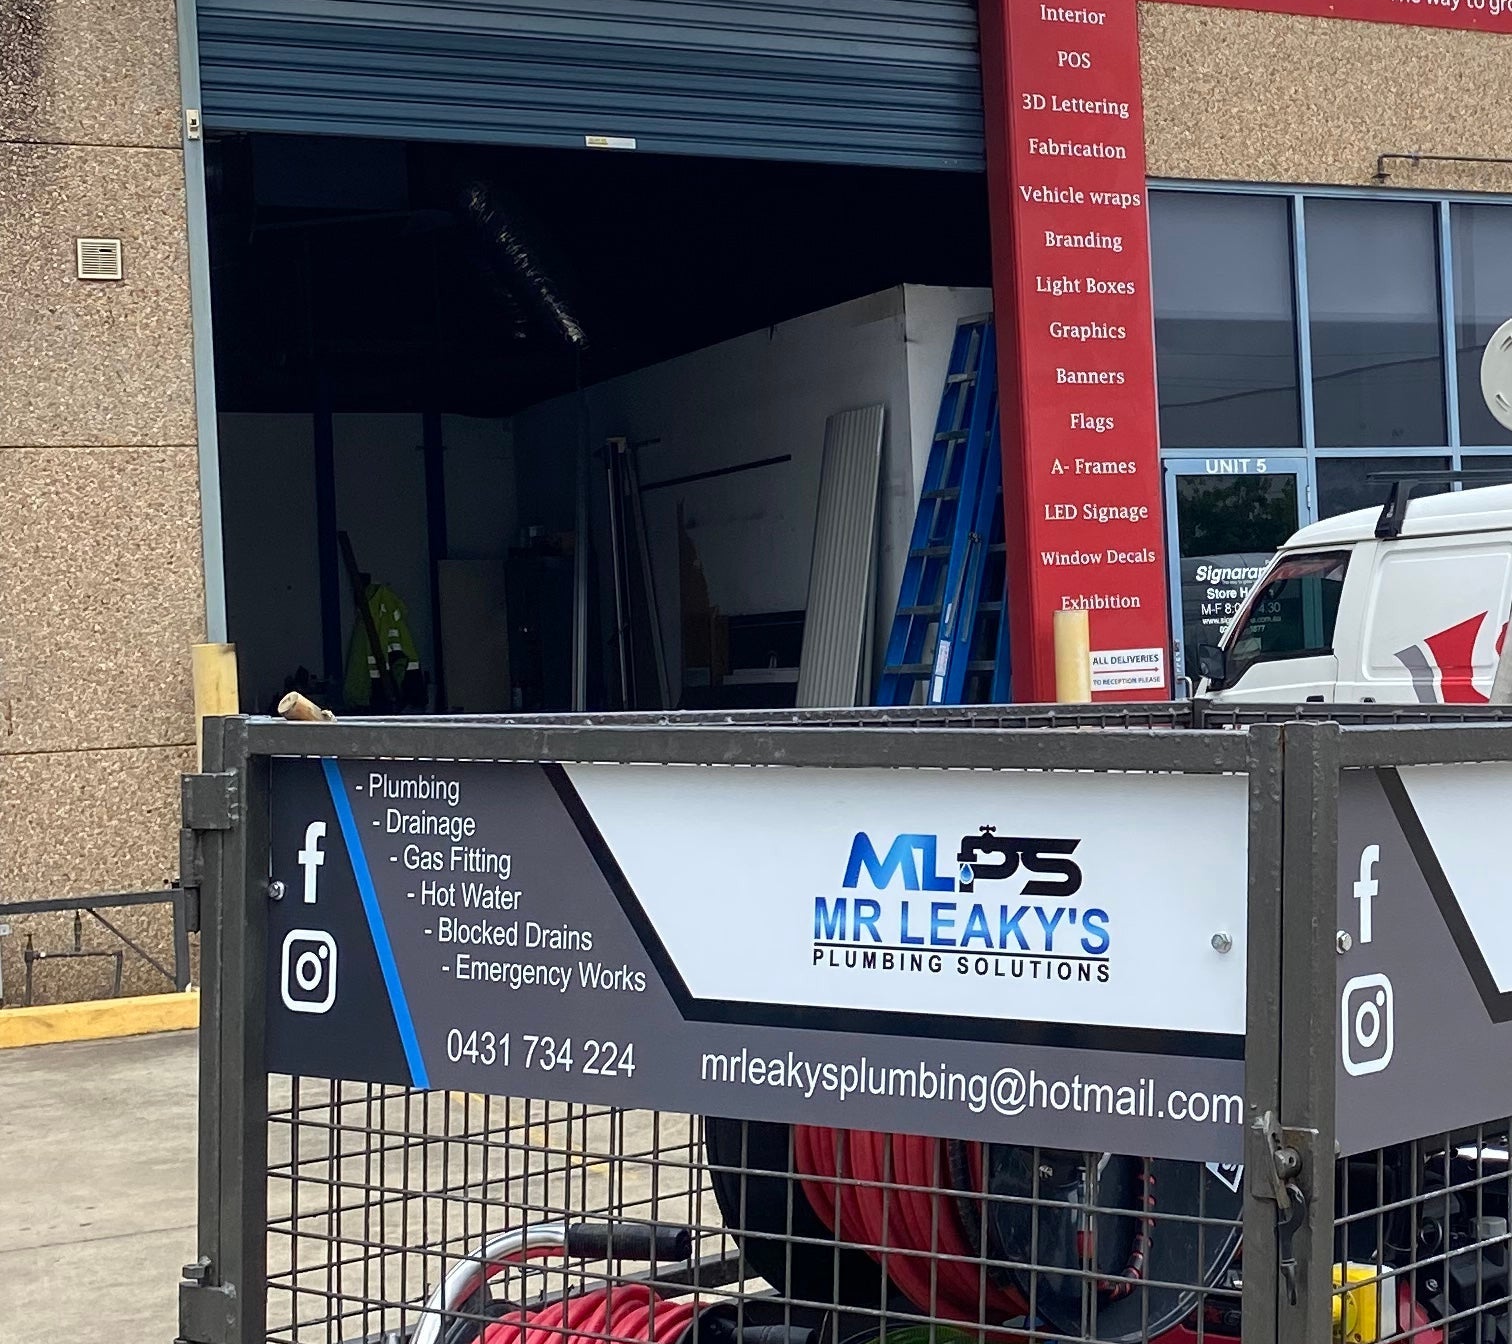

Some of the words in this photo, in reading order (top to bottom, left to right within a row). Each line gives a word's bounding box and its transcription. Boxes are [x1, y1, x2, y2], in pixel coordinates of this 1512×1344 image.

[1040, 4, 1106, 26] Interior
[1057, 50, 1091, 70] POS
[1022, 94, 1046, 113] 3D
[1051, 95, 1130, 120] Lettering
[1029, 138, 1127, 160] Fabrication
[1019, 185, 1086, 205] Vehicle
[1090, 190, 1141, 210] wraps
[1045, 230, 1123, 253] Branding
[1036, 275, 1081, 297] Light
[1086, 277, 1135, 296] Boxes
[1049, 321, 1126, 343] Graphics
[1056, 367, 1125, 386] Banners
[1070, 412, 1115, 433] Flags
[1051, 458, 1070, 475] A-
[1075, 458, 1137, 476] Frames
[1205, 458, 1251, 474] UNIT
[1256, 458, 1267, 473] 5
[1044, 503, 1077, 521] LED
[1082, 502, 1149, 524] Signage
[1041, 548, 1103, 566] Window
[1106, 547, 1156, 565] Decals
[1060, 592, 1141, 612] Exhibition
[1206, 588, 1238, 600] Store
[1201, 603, 1222, 615] M-F
[1092, 656, 1108, 666] ALL
[1110, 654, 1159, 665] DELIVERIES
[1103, 677, 1137, 685] RECEPTION
[1138, 676, 1160, 684] PLEASE
[368, 773, 461, 806] Plumbing
[385, 809, 476, 843] Drainage
[403, 845, 444, 872] Gas
[450, 846, 512, 880] Fitting
[421, 881, 456, 908] Hot
[461, 883, 522, 911] Water
[438, 916, 518, 948] Blocked
[525, 921, 593, 952] Drains
[814, 896, 881, 945] MR
[900, 900, 1111, 955] LEAKY'S
[456, 954, 573, 994] Emergency
[578, 961, 647, 993] Works
[812, 948, 943, 974] PLUMBING
[957, 956, 1111, 983] SOLUTIONS
[447, 1028, 511, 1067] 0431
[523, 1034, 574, 1073] 734
[582, 1040, 637, 1078] 224
[701, 1048, 1244, 1126] mrleakysplumbing@hotmail.com
